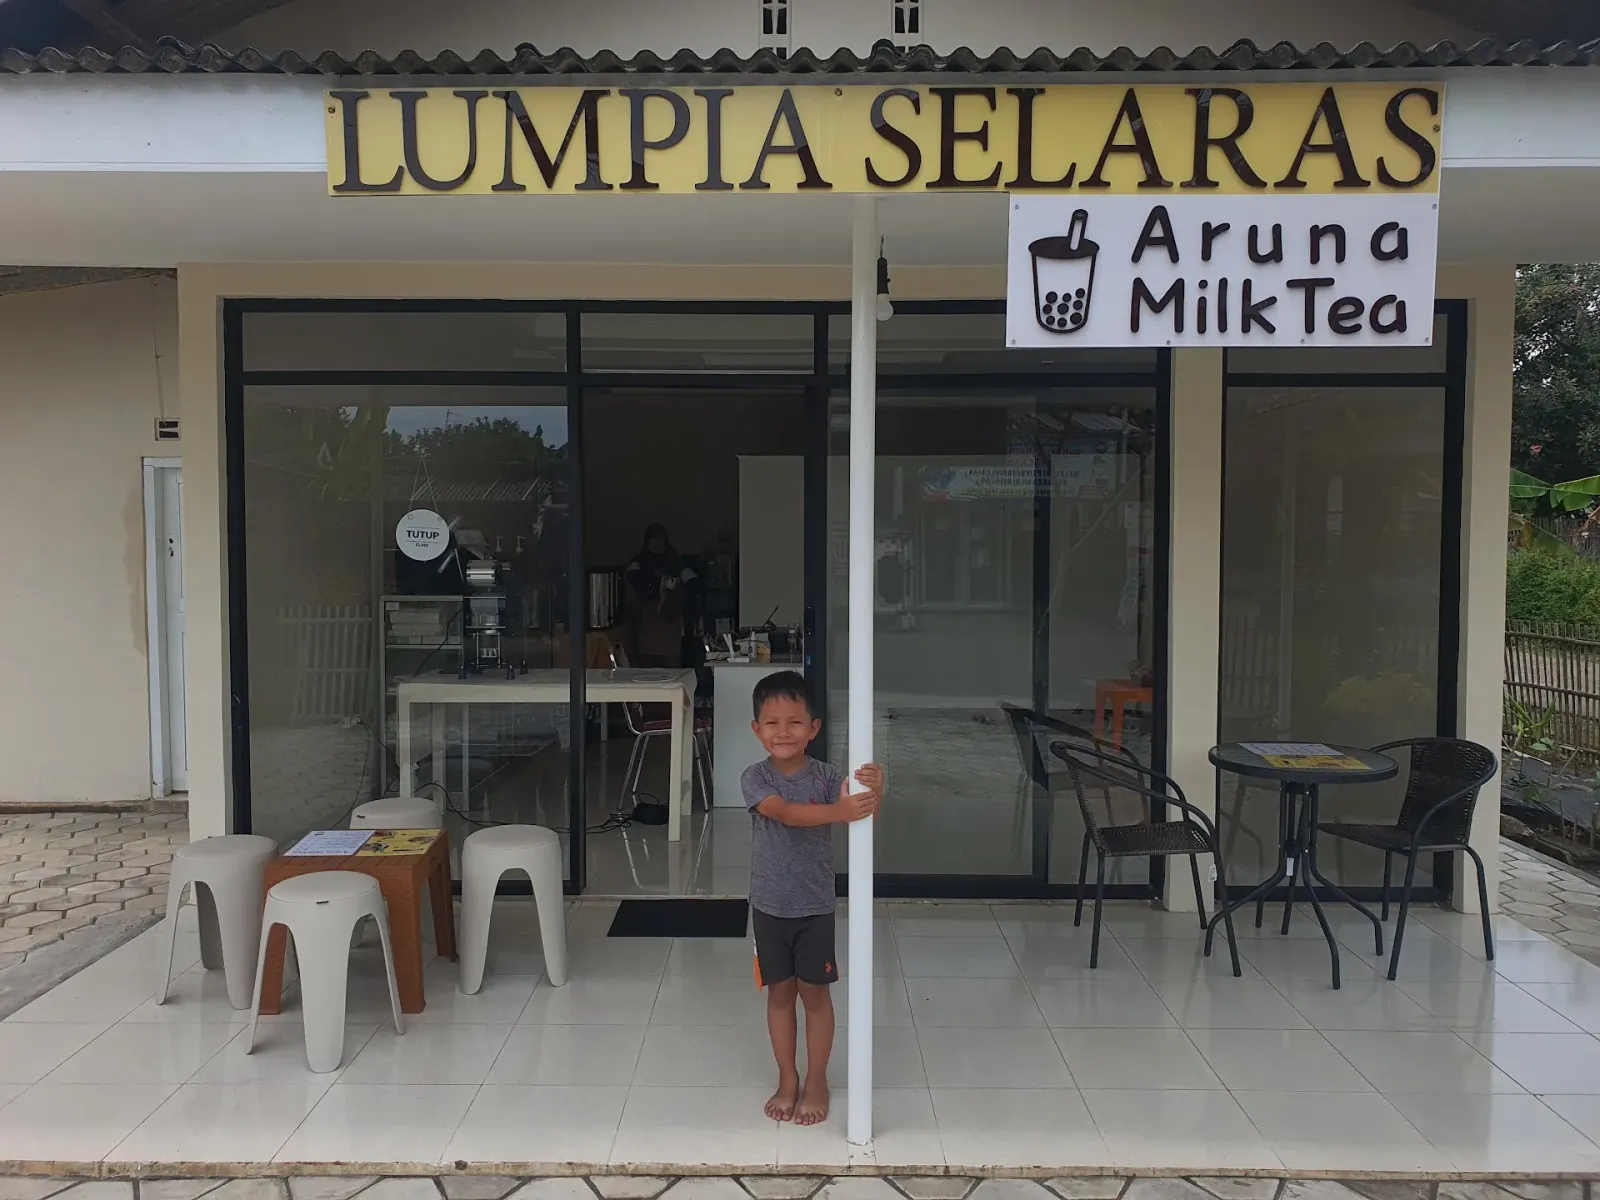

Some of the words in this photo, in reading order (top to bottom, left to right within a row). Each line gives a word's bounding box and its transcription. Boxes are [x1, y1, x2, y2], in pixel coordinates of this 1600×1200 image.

[330, 88, 833, 191] LUMPIA
[865, 87, 1439, 189] SELARAS
[1131, 204, 1409, 264] Aruna
[406, 530, 440, 539] TUTUP
